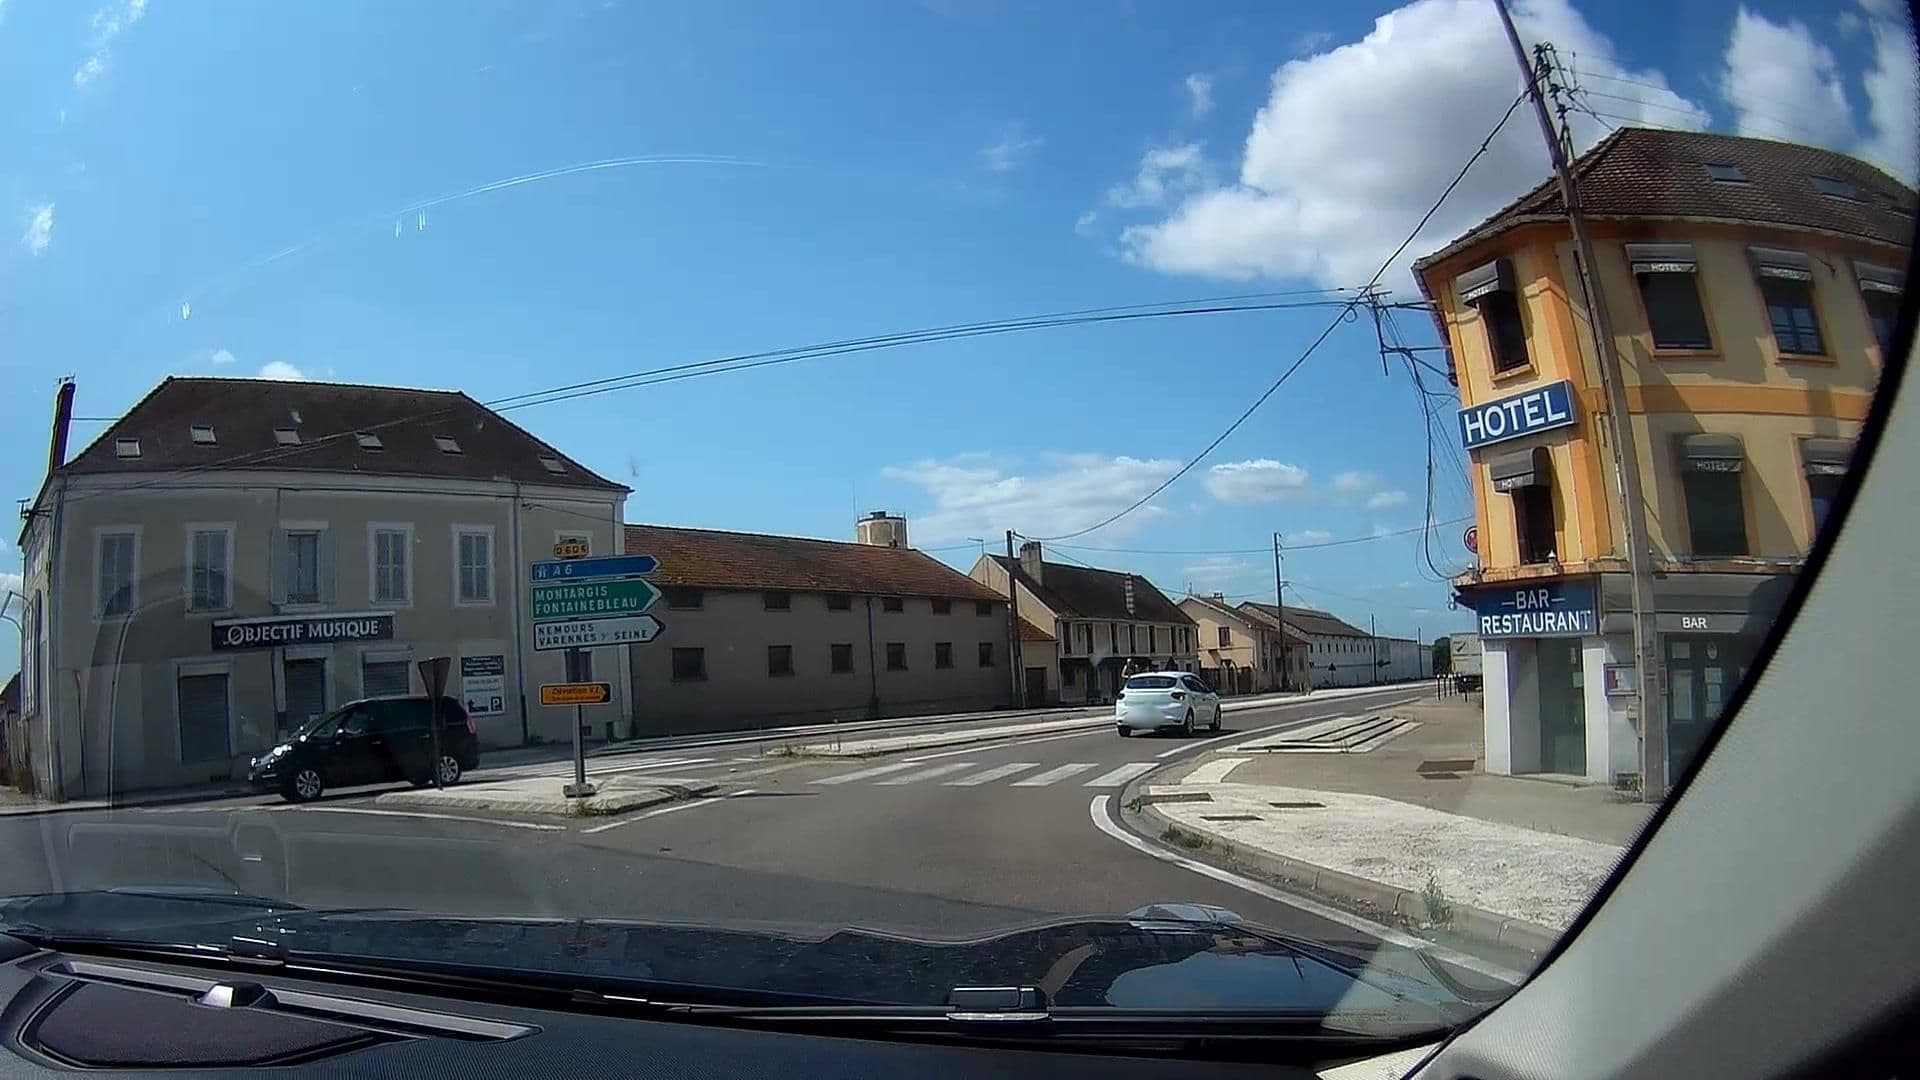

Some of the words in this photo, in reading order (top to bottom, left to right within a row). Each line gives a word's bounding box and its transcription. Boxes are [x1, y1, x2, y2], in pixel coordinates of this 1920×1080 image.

[1463, 390, 1567, 443] HOTEL
[1696, 460, 1728, 472] HOTEL
[535, 585, 608, 602] MONTARGIS
[535, 597, 637, 614] FONTAINEBLEAU
[308, 620, 379, 639] MUSIQUE
[537, 623, 595, 635] NEMOURS
[1481, 610, 1591, 635] RESTAURANT
[1682, 616, 1708, 629] BAR
[538, 632, 597, 647] VARENNES
[614, 629, 649, 640] SEINE
